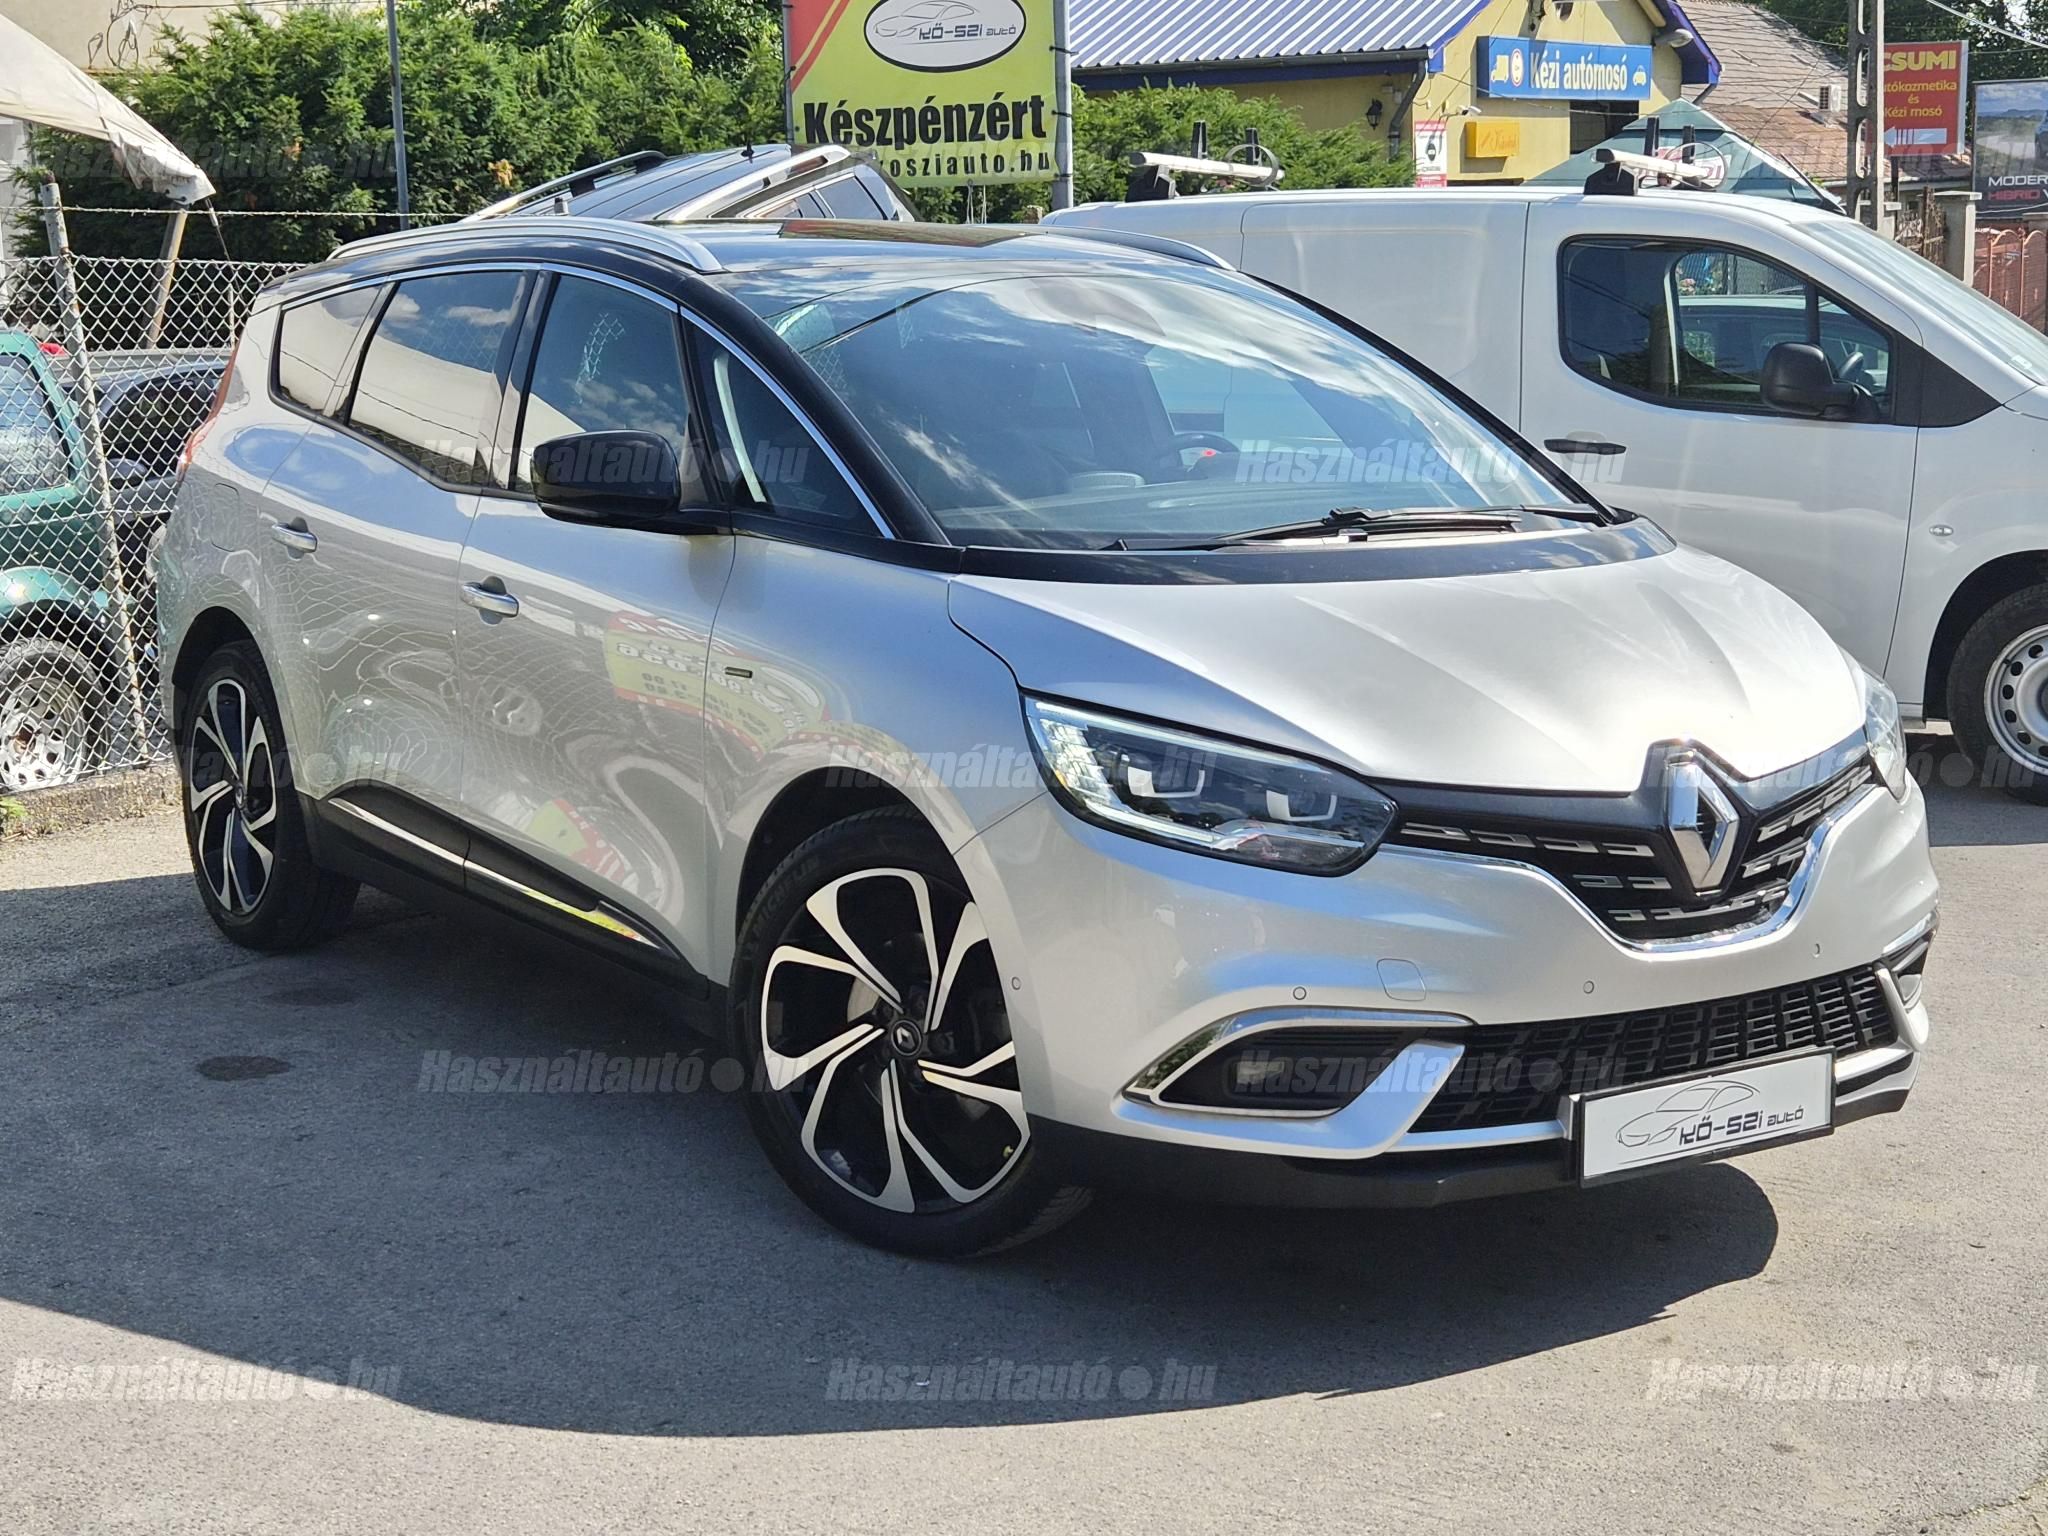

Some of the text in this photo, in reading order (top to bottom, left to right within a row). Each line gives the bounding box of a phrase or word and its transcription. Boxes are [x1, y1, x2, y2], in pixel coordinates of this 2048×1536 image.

[986, 24, 1017, 37] autó
[1530, 49, 1628, 91] Kézi autómosó
[1884, 80, 1957, 93] tókozmetika
[1907, 93, 1920, 104] és
[1884, 104, 1943, 118] Kézi mosó
[803, 91, 1047, 150] Készpénzért
[879, 150, 1050, 178] osziauto.hu
[1767, 1104, 1804, 1126] autó
